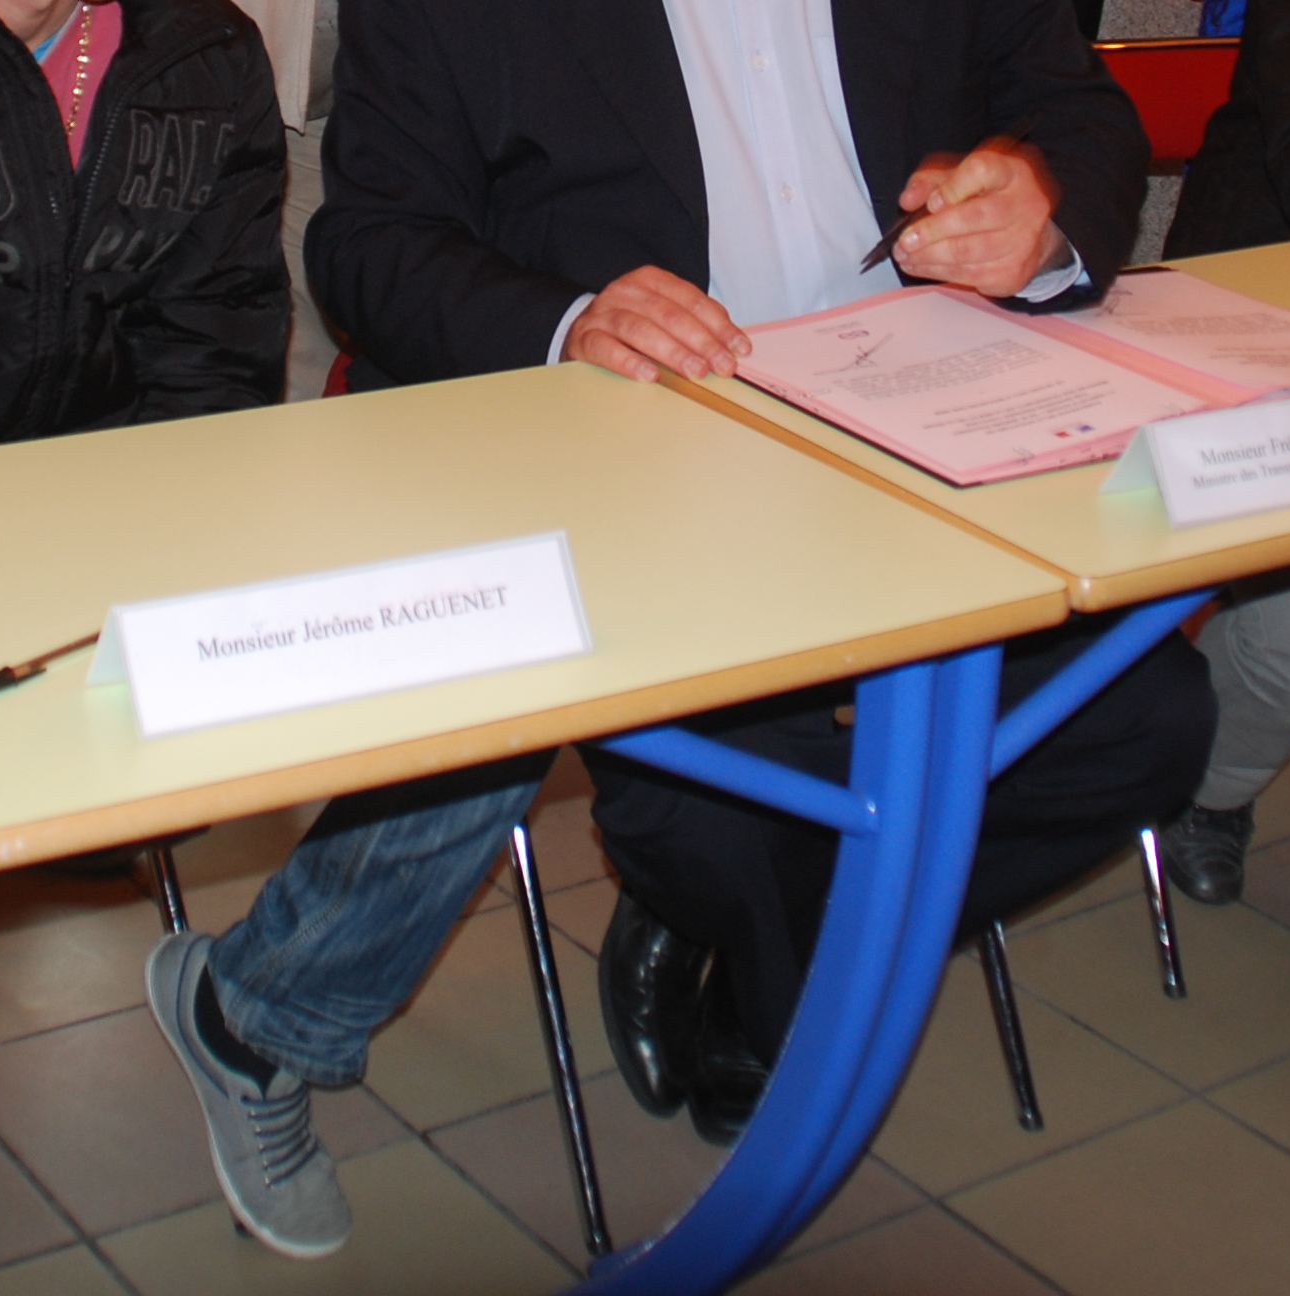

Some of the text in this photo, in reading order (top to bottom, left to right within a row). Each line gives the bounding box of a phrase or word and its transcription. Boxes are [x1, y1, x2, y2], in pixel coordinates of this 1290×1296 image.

[1200, 444, 1267, 467] Monsieur
[1192, 470, 1237, 490] Ministre
[1240, 466, 1259, 483] des
[196, 585, 508, 662] Monsieur Jérôme RAGUENET
